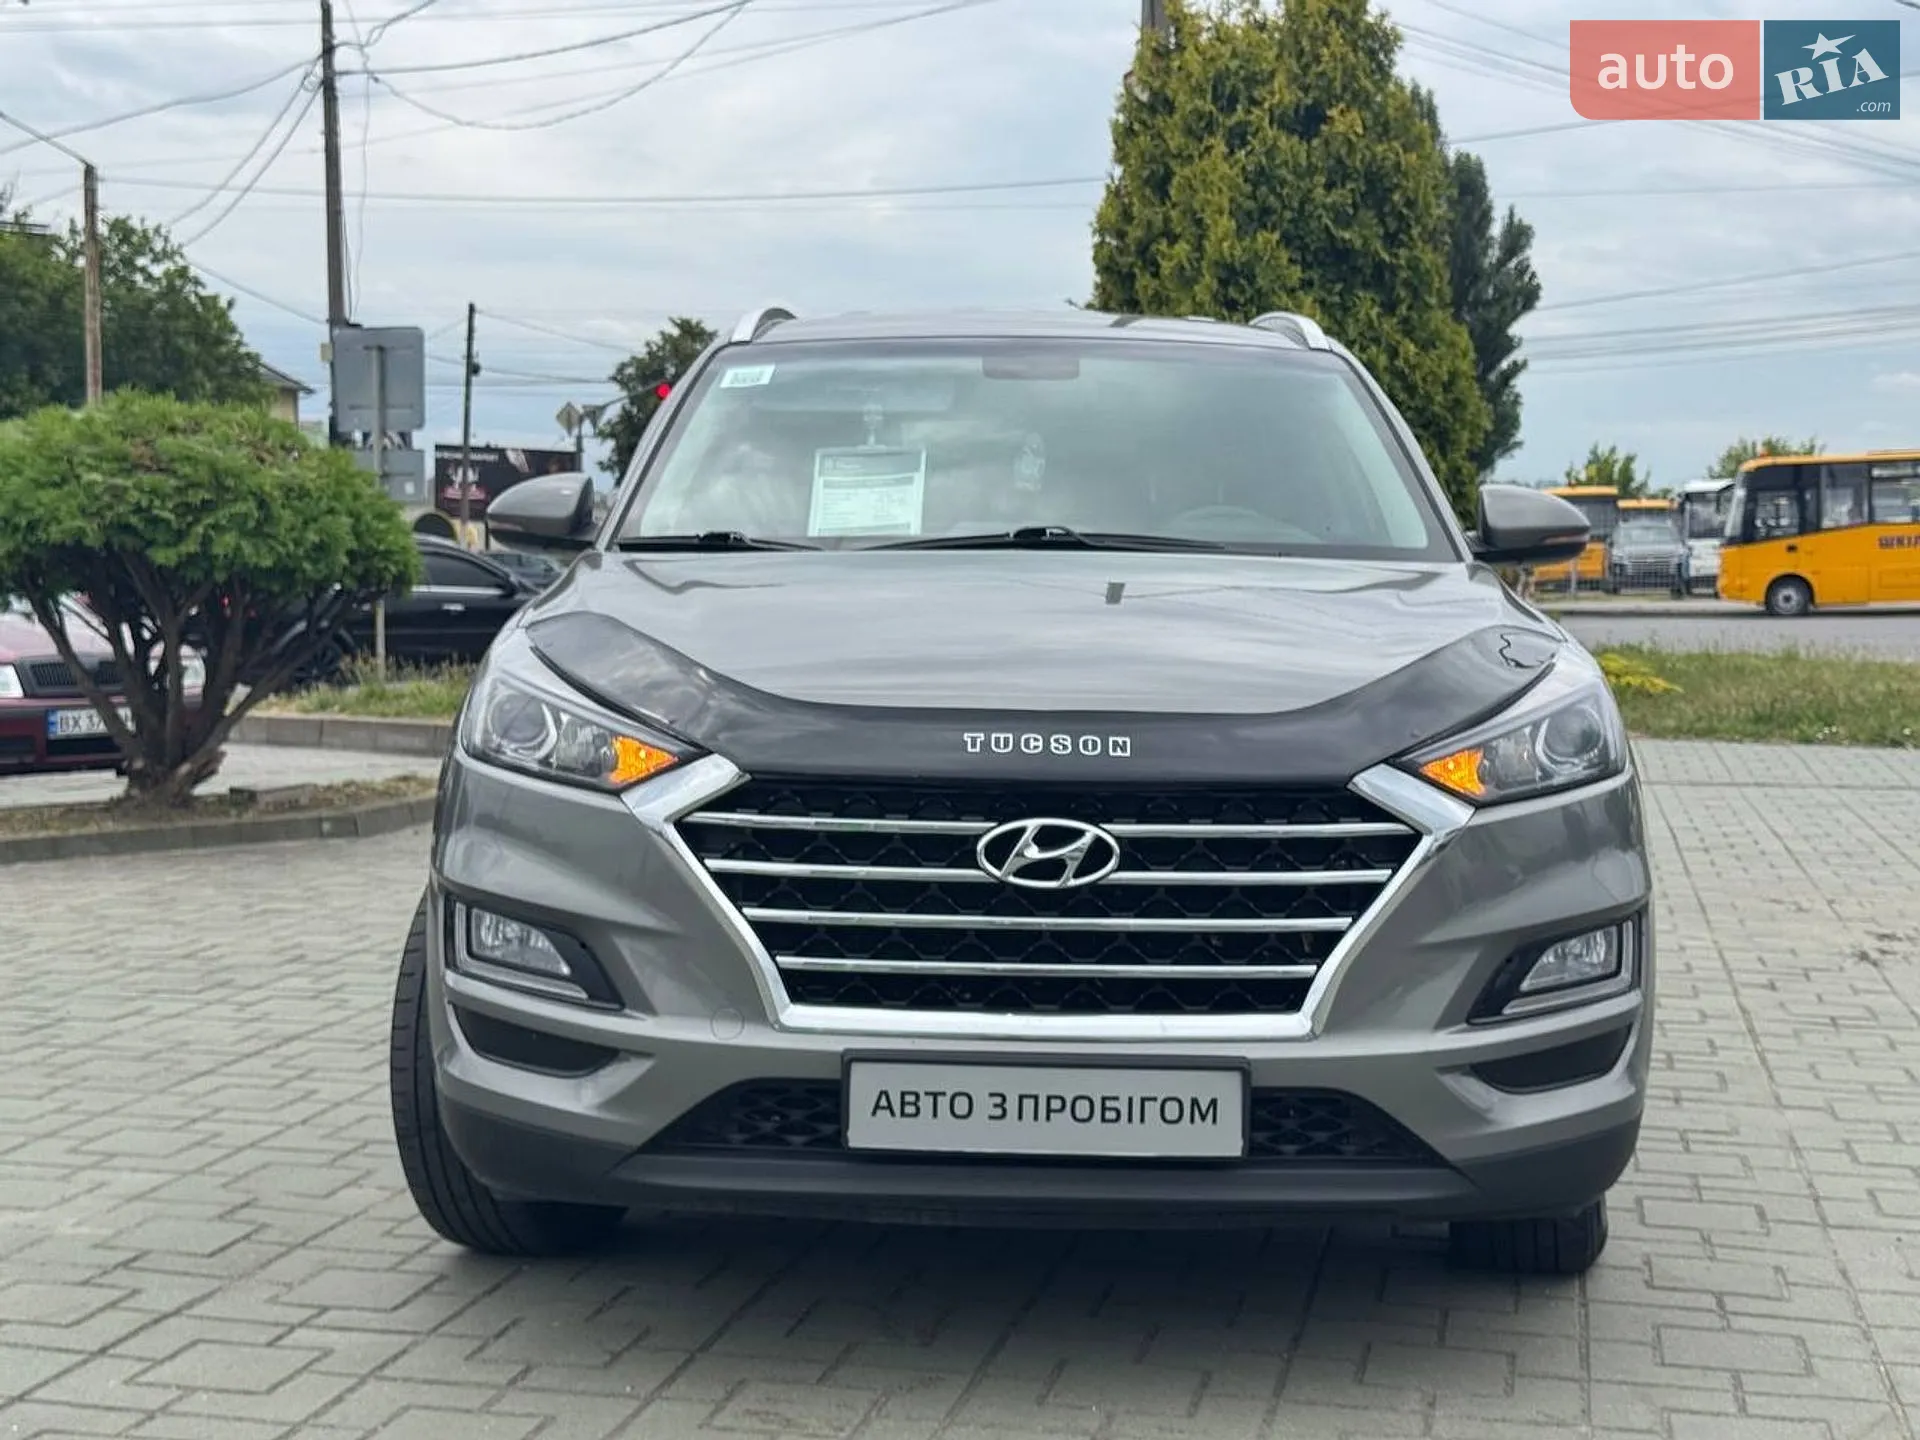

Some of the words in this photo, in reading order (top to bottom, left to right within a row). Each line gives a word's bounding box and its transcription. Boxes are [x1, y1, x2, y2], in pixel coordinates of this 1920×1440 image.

[963, 732, 1132, 758] TUCSON
[871, 1089, 975, 1120] АВТО
[1016, 1093, 1219, 1125] ПРОБІГОМ
